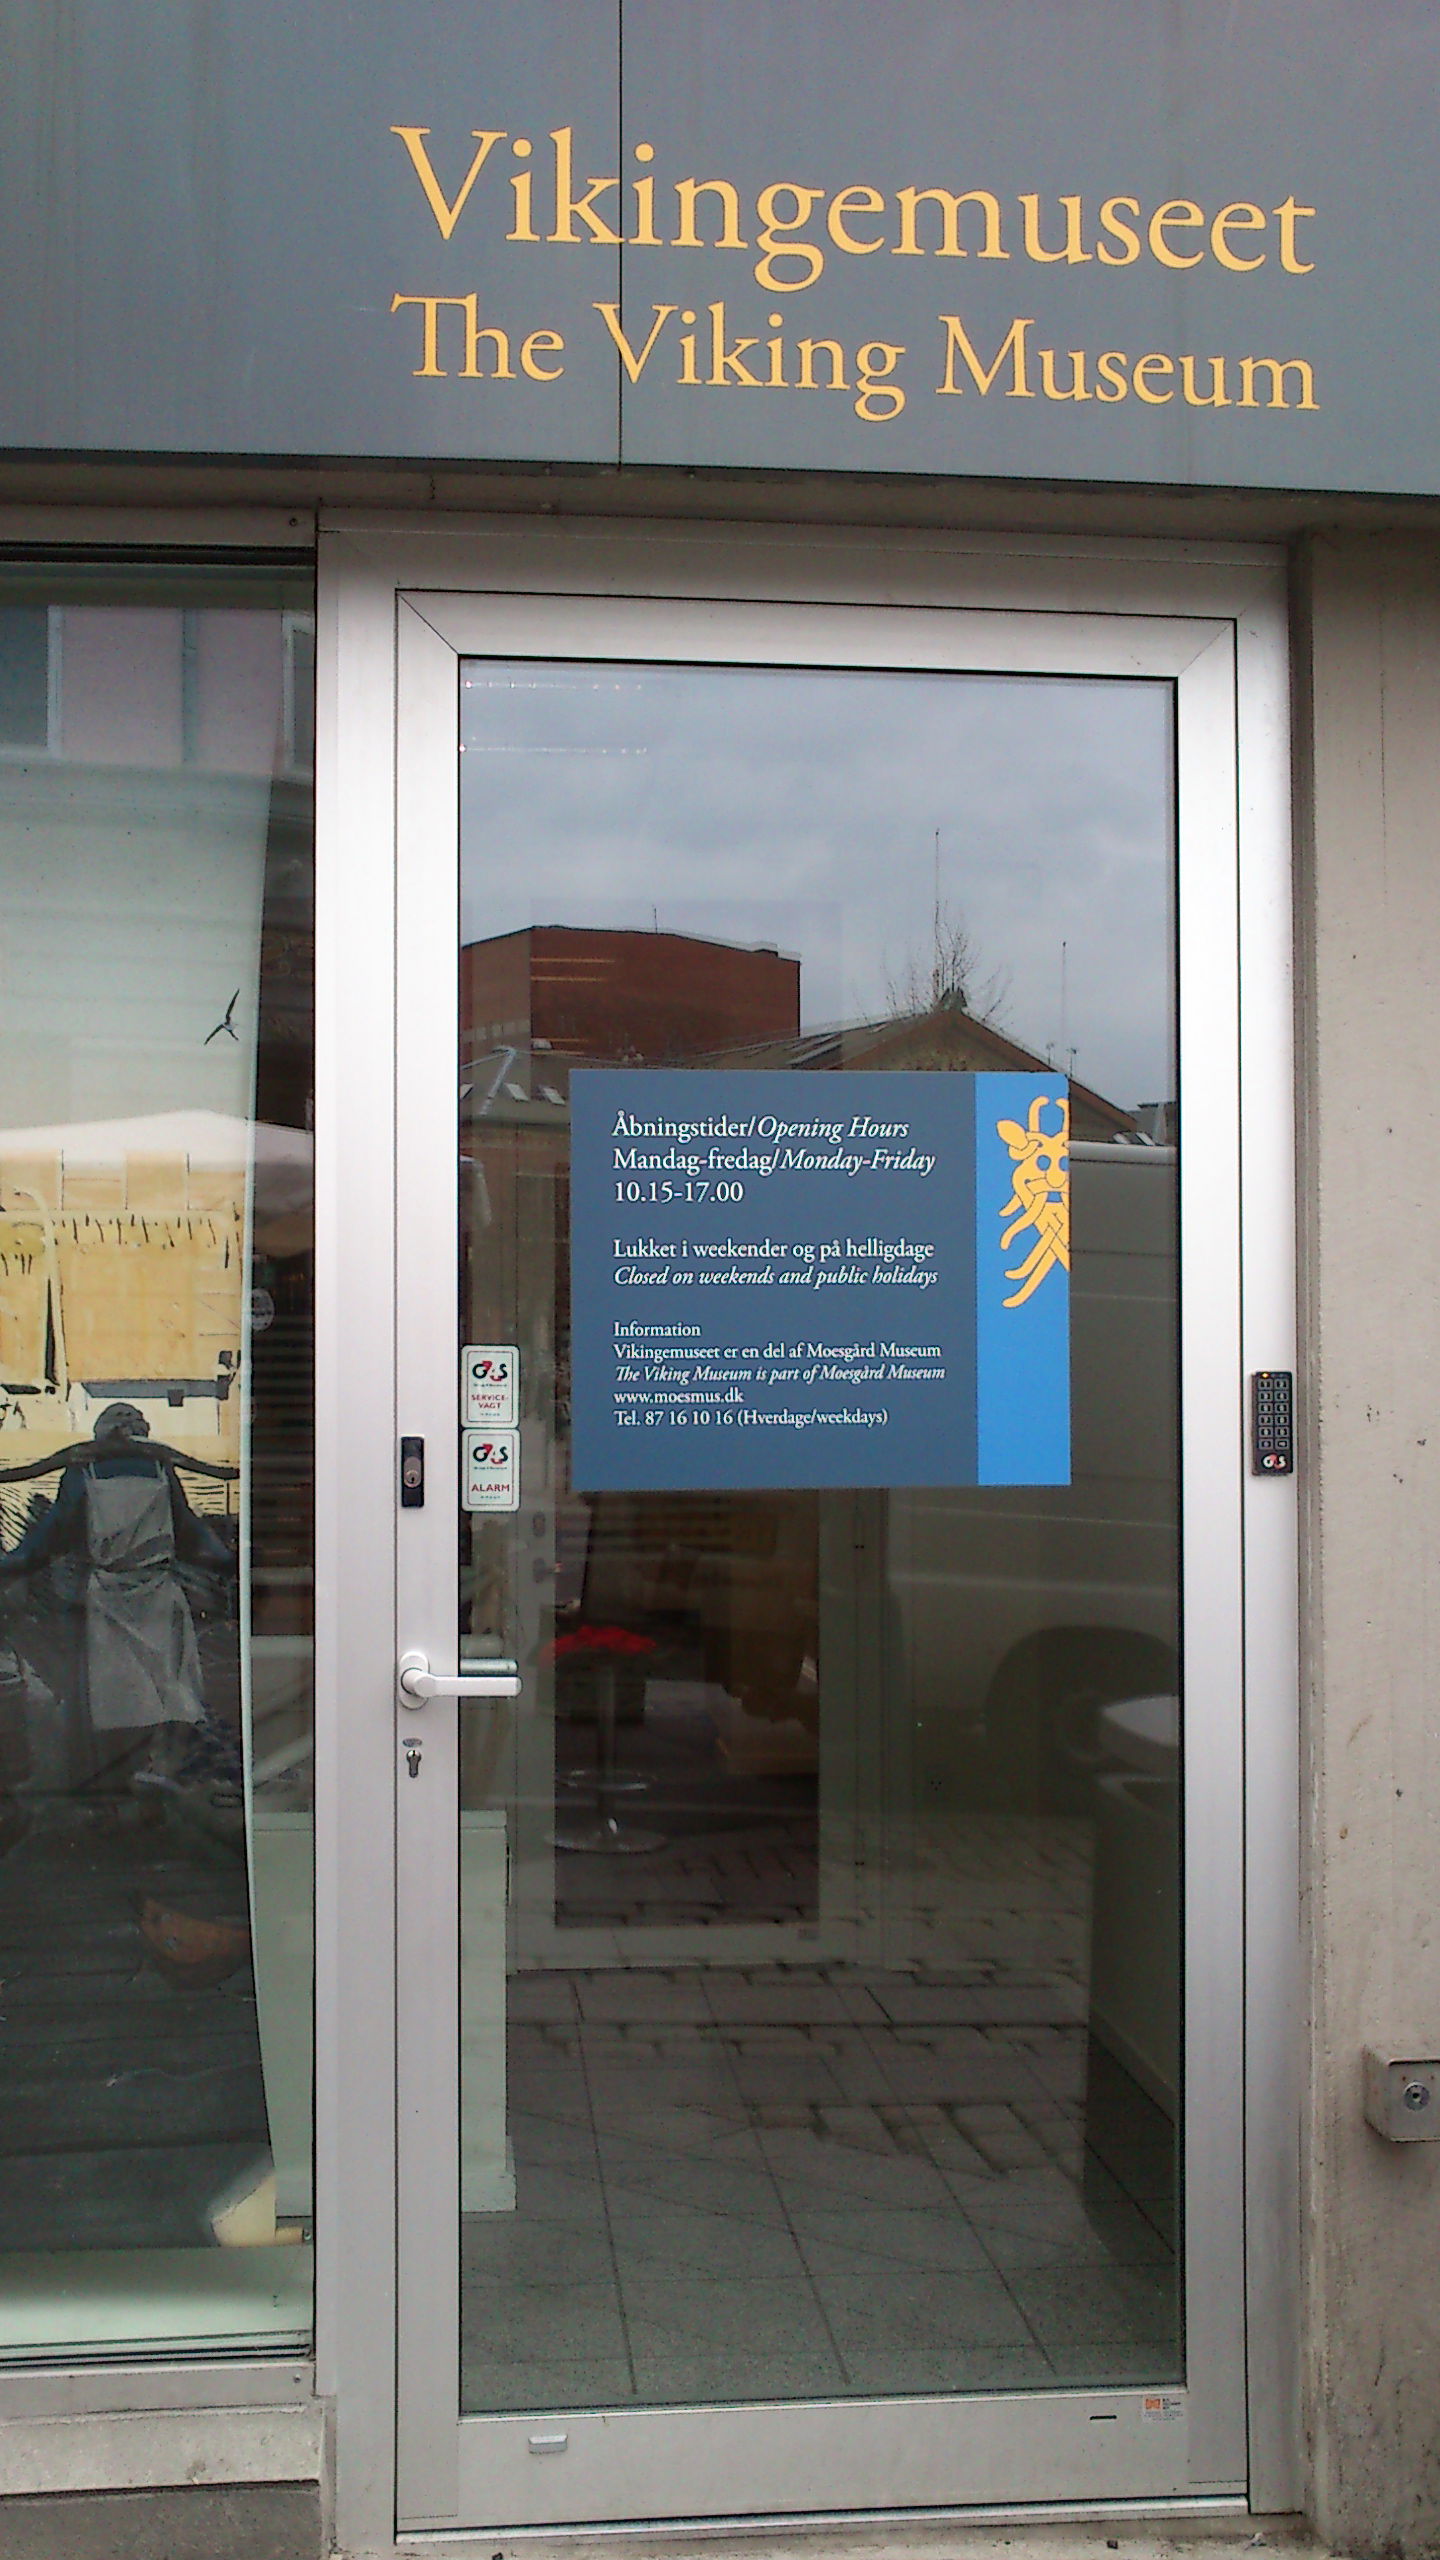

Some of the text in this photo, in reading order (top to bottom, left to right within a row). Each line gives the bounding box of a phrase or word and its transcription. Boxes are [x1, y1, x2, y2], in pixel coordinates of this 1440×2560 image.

[389, 124, 1316, 292] Vikingemuseet
[390, 291, 1320, 422] The Viking Museum
[611, 1110, 910, 1143] Åbningstider/Opening Hours
[612, 1147, 936, 1176] Mandag-fredag/Monday-Friday
[614, 1181, 744, 1203] 10.15-17.00
[613, 1238, 934, 1263] Lukket i weekender og på helligdage
[613, 1265, 938, 1289] Closed on weekends and public holidays
[613, 1320, 701, 1337] Information
[612, 1342, 941, 1363] Vikingemuseet er en del af Moesgård Museum
[615, 1363, 946, 1386] The Viking Museum is part of Moesgård Museum
[613, 1386, 744, 1403] www.moesmus.dk
[613, 1408, 889, 1429] Tel. 87 16 10 16 (Hverdage/weekdays)
[471, 1483, 510, 1492] ALARM
